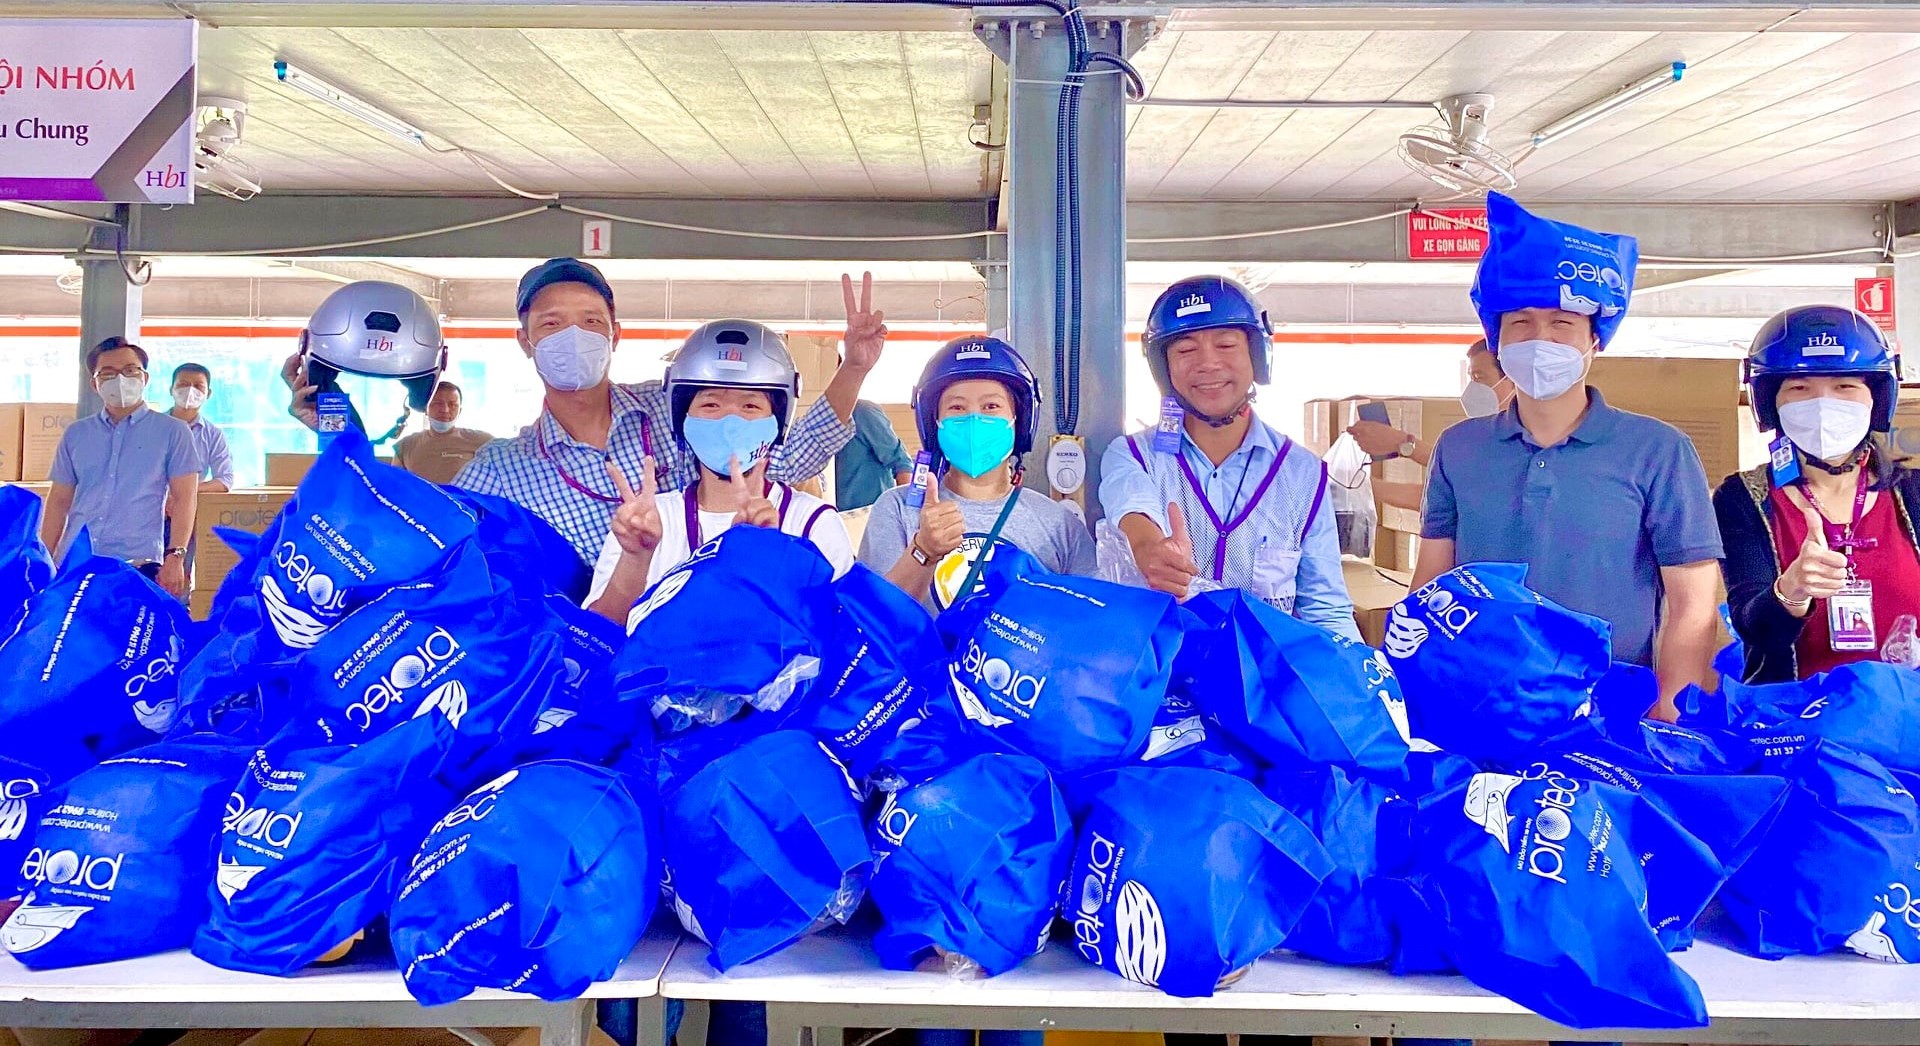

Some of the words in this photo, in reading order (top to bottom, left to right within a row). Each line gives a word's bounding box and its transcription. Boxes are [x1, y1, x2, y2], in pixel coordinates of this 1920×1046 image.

[36, 60, 135, 91] NHÓM
[15, 118, 89, 146] Chung
[1412, 217, 1427, 231] VUI
[591, 227, 601, 250] 1
[1423, 238, 1435, 252] XE
[219, 507, 276, 528] prote
[334, 535, 352, 551] 0962
[999, 616, 1019, 630] 0962
[339, 620, 412, 688] www.protec.com.vn
[346, 625, 460, 730] protec
[883, 677, 907, 702] Hotline:
[865, 702, 884, 721] 0962
[857, 720, 867, 730] 31
[223, 792, 302, 848] prote
[20, 847, 125, 891] prote
[1075, 831, 1115, 965] protec
